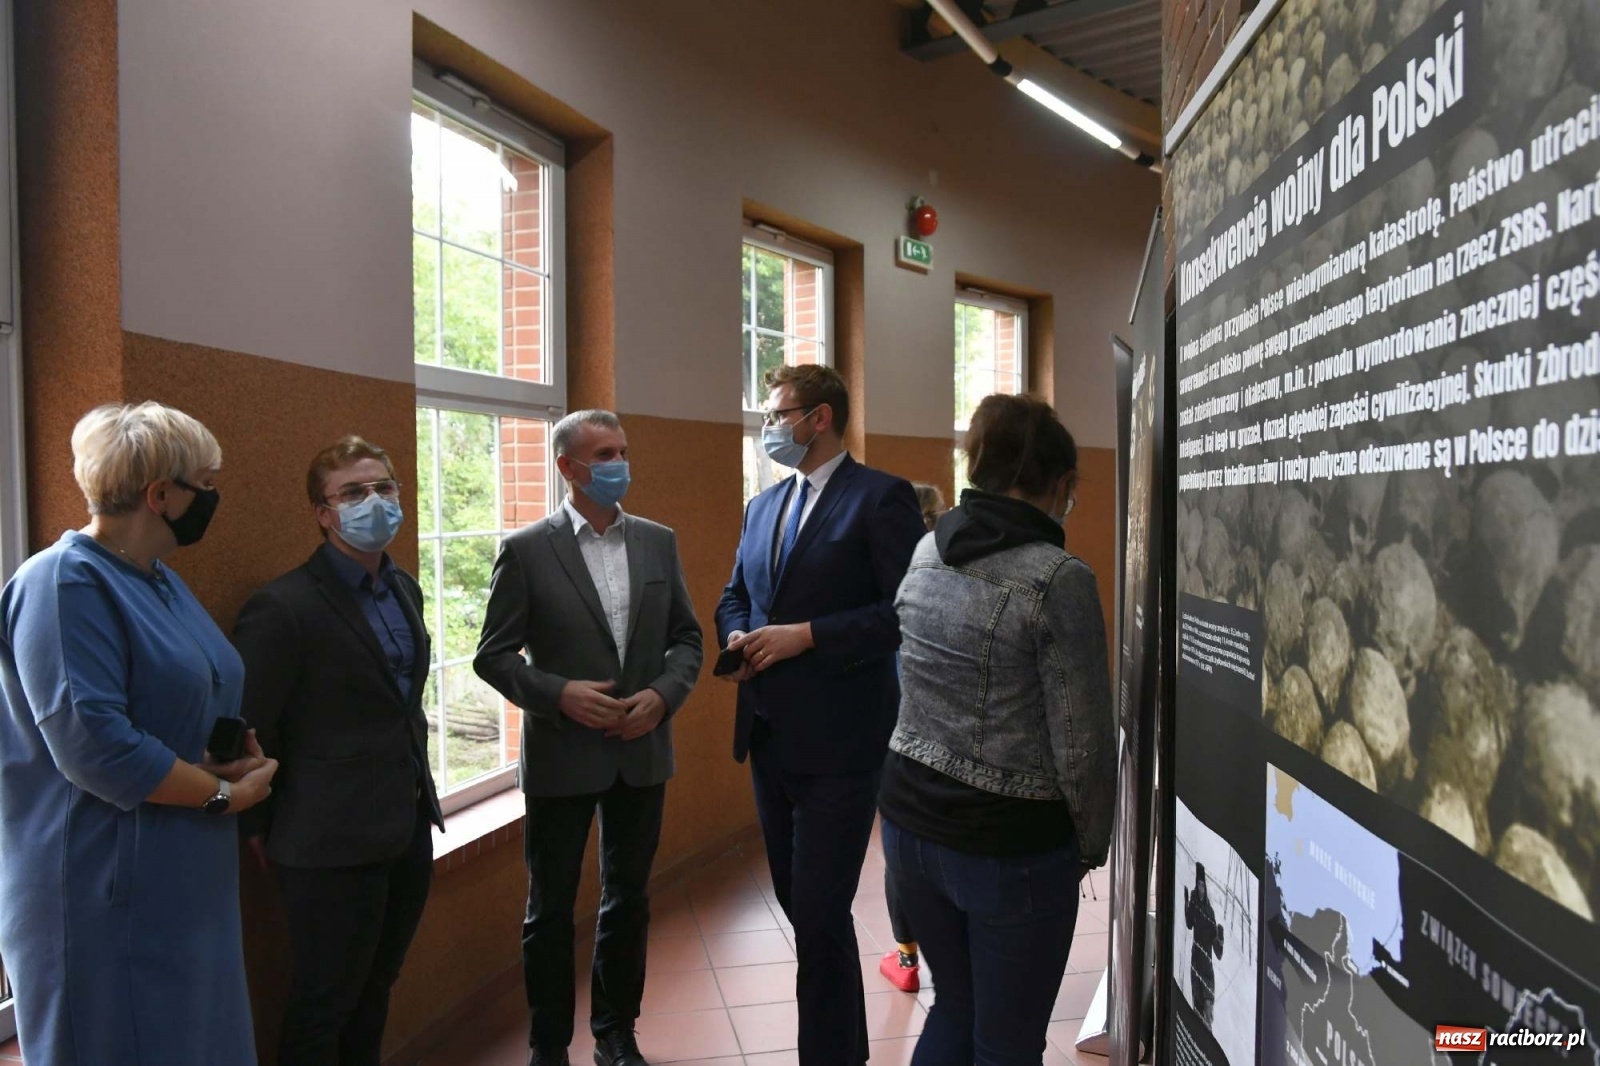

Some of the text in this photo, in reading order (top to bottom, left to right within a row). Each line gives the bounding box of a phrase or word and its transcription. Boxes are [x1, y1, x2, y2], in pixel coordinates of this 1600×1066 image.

[1181, 10, 1463, 306] Konsekwencje wojny dla Polski
[1184, 339, 1199, 361] wojna
[1200, 331, 1222, 353] światowa
[1224, 303, 1259, 342] przyniosła
[1260, 288, 1284, 320] Polsce
[1286, 240, 1366, 305] wielowymiarową
[1369, 197, 1445, 260] katastrofę.
[1450, 148, 1524, 217] Państwo
[1209, 361, 1220, 381] oraz
[1220, 352, 1241, 377] blisko
[1242, 342, 1264, 372] połowę
[1264, 330, 1288, 359] swego
[1289, 294, 1364, 351] przedwojennego
[1366, 262, 1434, 315] terytorium
[1436, 252, 1454, 286] na
[1456, 229, 1497, 276] rzecz
[1500, 201, 1552, 257] ZSRS.
[1215, 429, 1228, 452] legł
[1229, 430, 1236, 449] w
[1237, 421, 1262, 450] gruzach,
[1263, 413, 1287, 441] doznał
[1288, 401, 1328, 443] głębokiej
[1329, 391, 1369, 430] zapaści
[1371, 364, 1471, 421] cywilizacyjnej.
[1474, 347, 1532, 398] Skutki
[1240, 386, 1244, 409] i
[1245, 377, 1282, 407] okaleczony,
[1284, 365, 1306, 393] m.in.
[1308, 364, 1313, 386] z
[1314, 347, 1353, 388] powodu
[1356, 309, 1457, 372] wymordowania
[1460, 273, 1540, 338] znacznej
[1207, 469, 1223, 491] przez
[1224, 463, 1256, 487] totalitarne
[1280, 457, 1283, 481] i
[1284, 455, 1308, 482] ruchy
[1309, 450, 1357, 482] polityczne
[1359, 444, 1431, 474] odczuwane
[1434, 437, 1452, 478] są
[1454, 435, 1467, 466] w
[1469, 426, 1528, 464] Polsce
[1532, 418, 1560, 459] do
[1421, 910, 1477, 980] ZWIĄZEK
